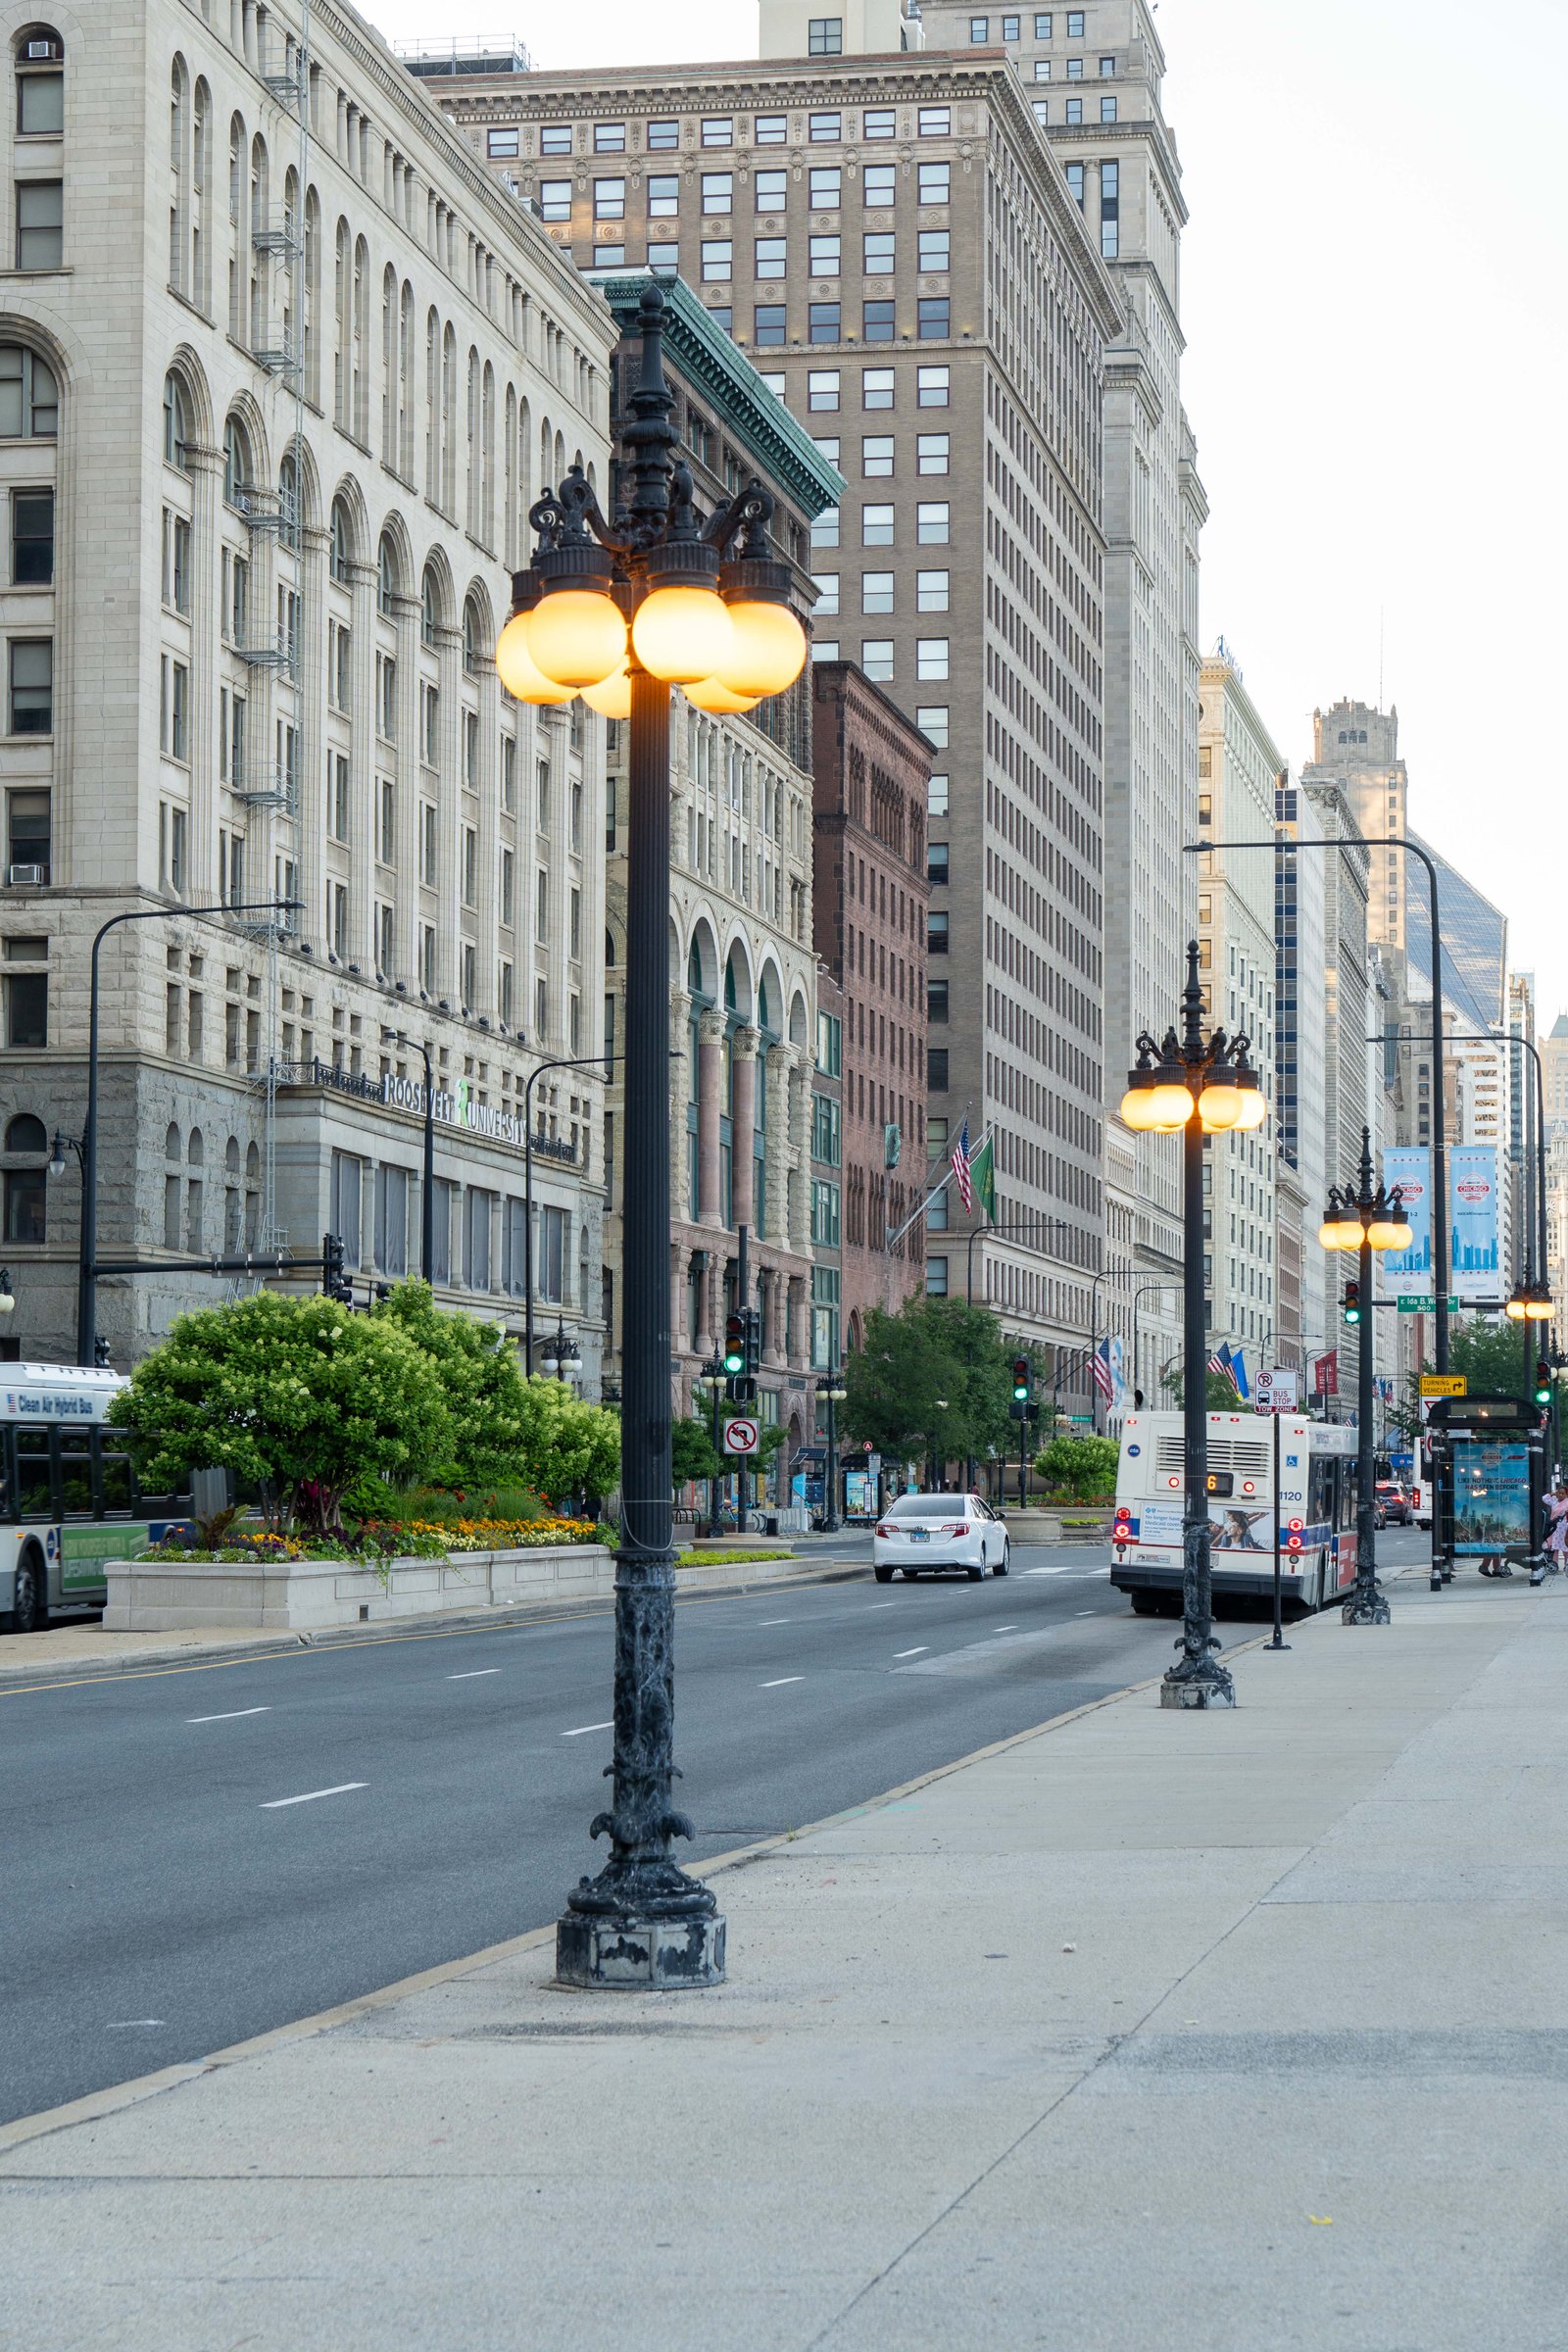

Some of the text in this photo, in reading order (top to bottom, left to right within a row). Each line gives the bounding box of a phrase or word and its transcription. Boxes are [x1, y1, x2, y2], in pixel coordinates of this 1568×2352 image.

[385, 1074, 455, 1123] ROOSEVELT
[1407, 1297, 1418, 1305] Ida
[19, 1394, 93, 1417] Clean Air Hybrid Bus
[1206, 1475, 1217, 1491] 6
[1278, 1491, 1302, 1501] 1120
